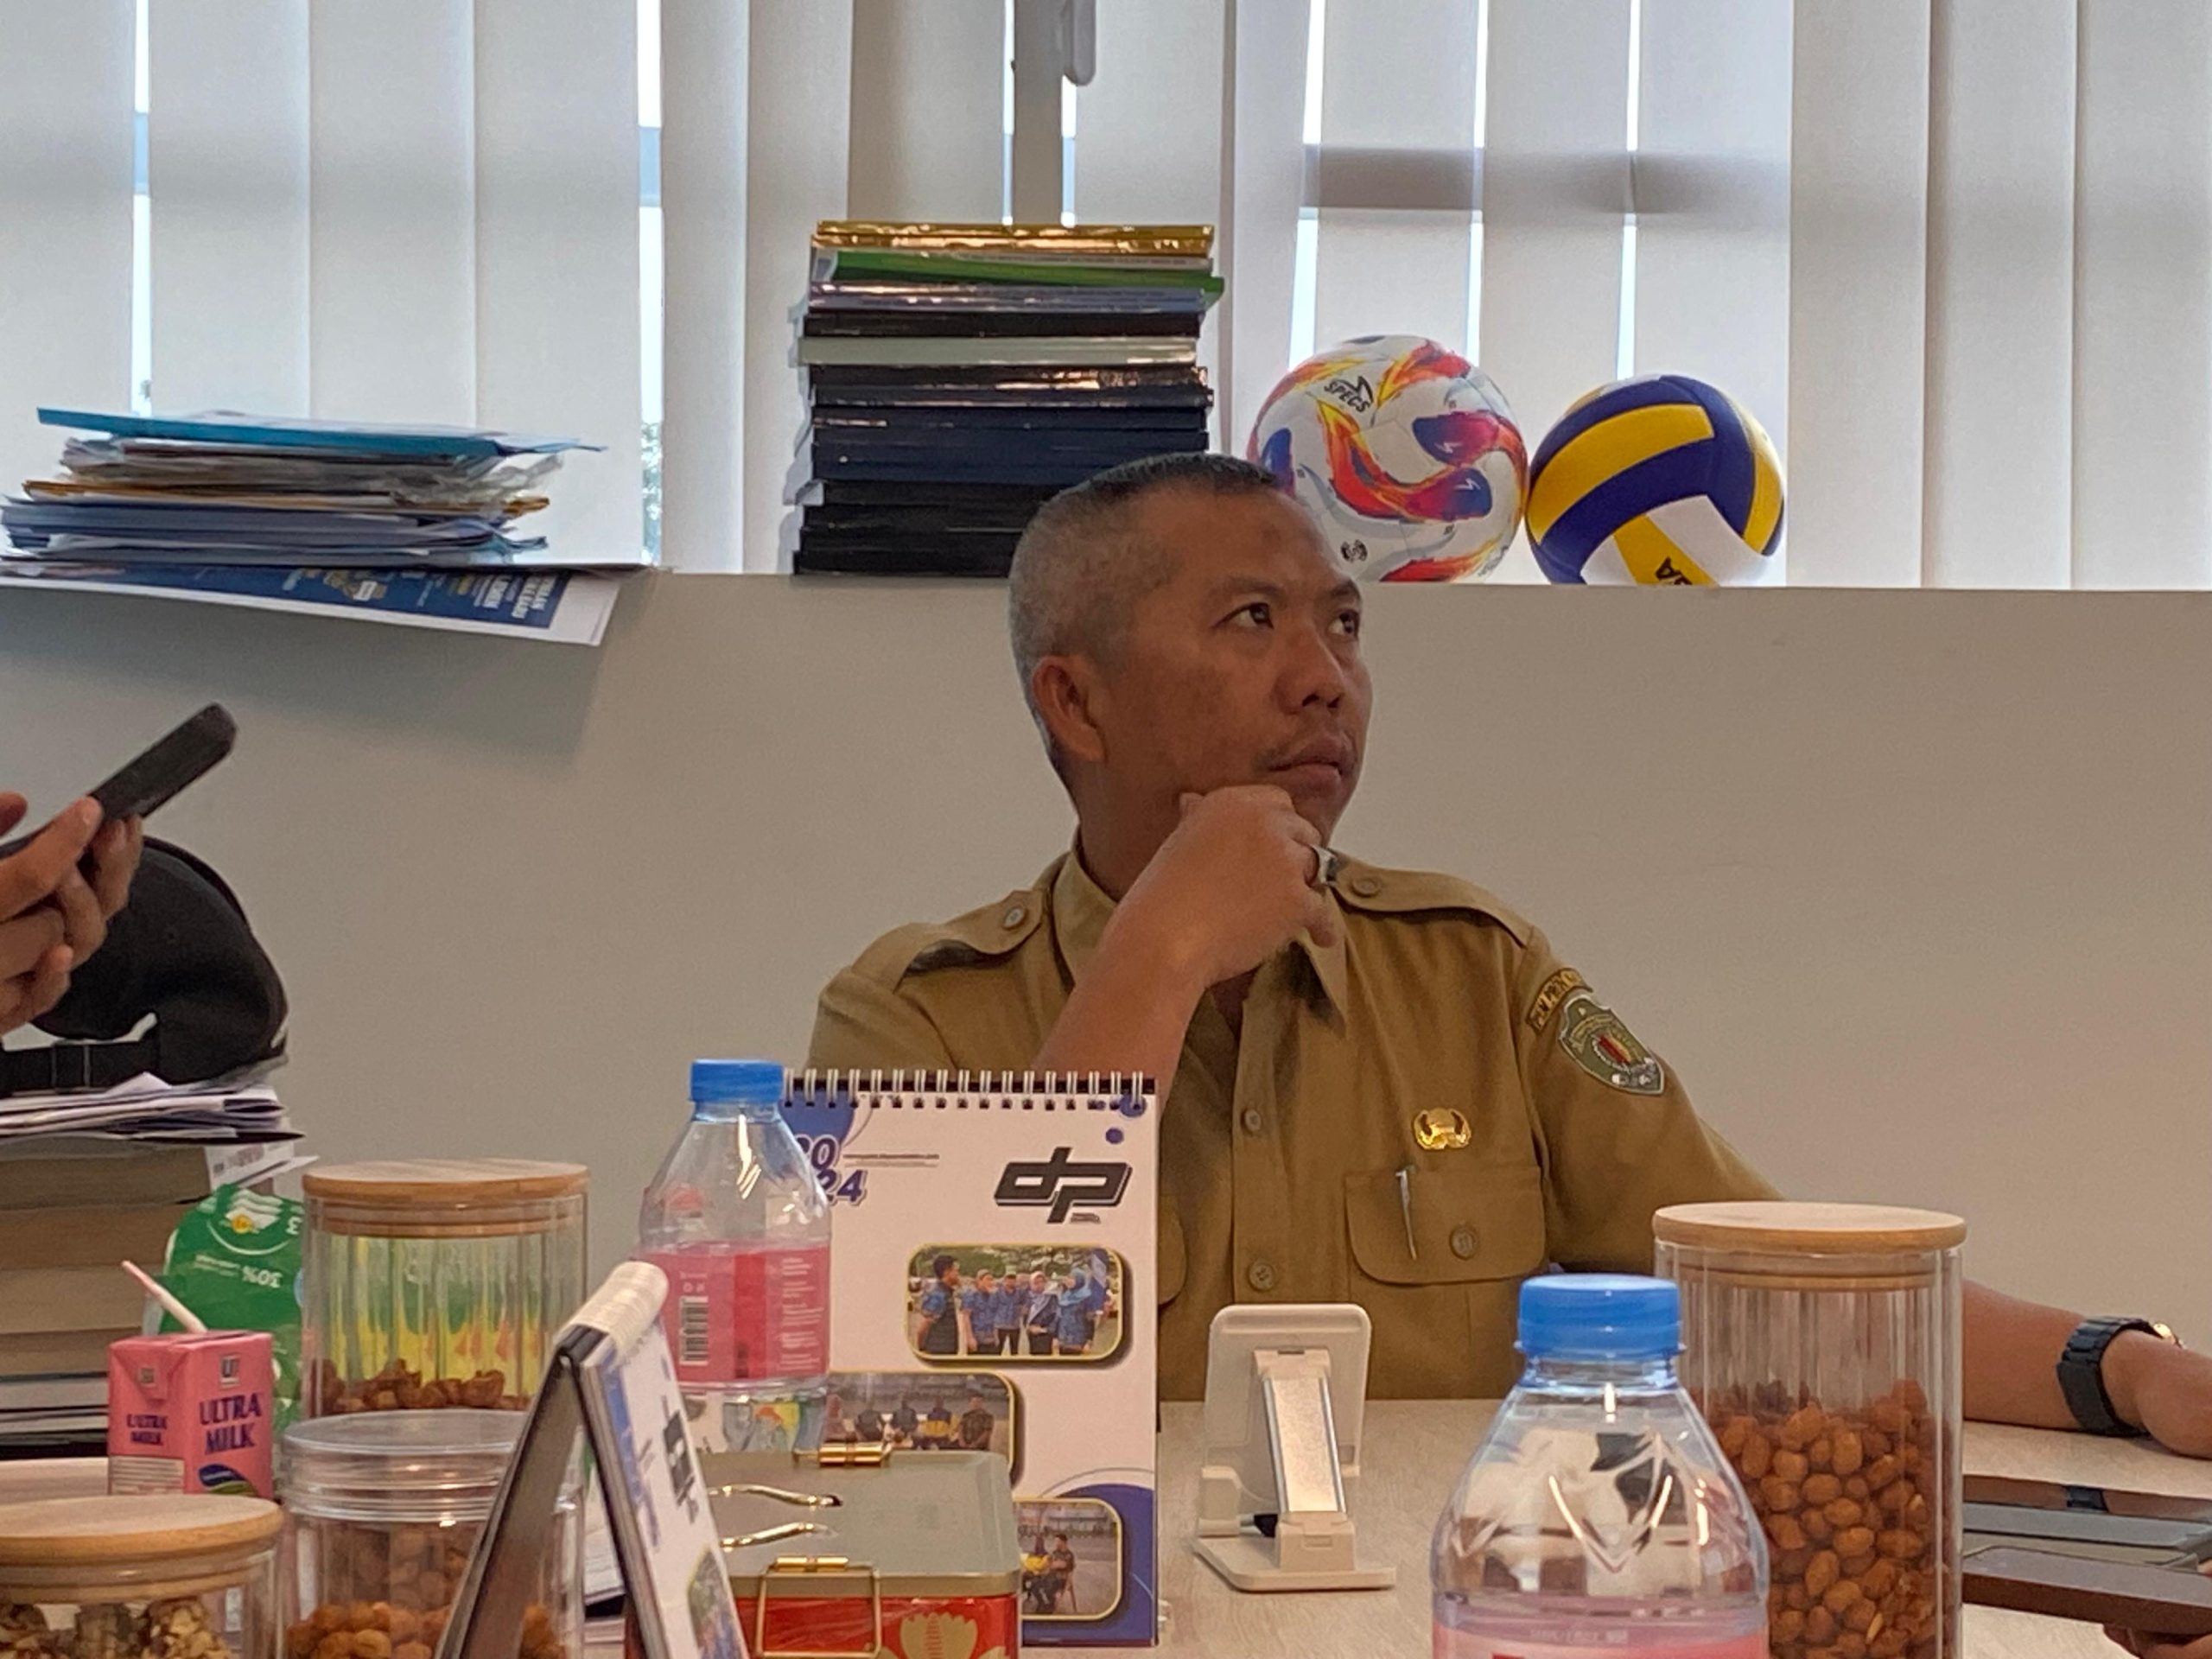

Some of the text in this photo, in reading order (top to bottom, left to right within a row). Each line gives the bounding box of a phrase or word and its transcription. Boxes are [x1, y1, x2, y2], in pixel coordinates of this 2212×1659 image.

[1324, 380, 1370, 412] SPECS
[199, 1393, 263, 1426] ULTRA
[205, 1423, 256, 1455] MILK
